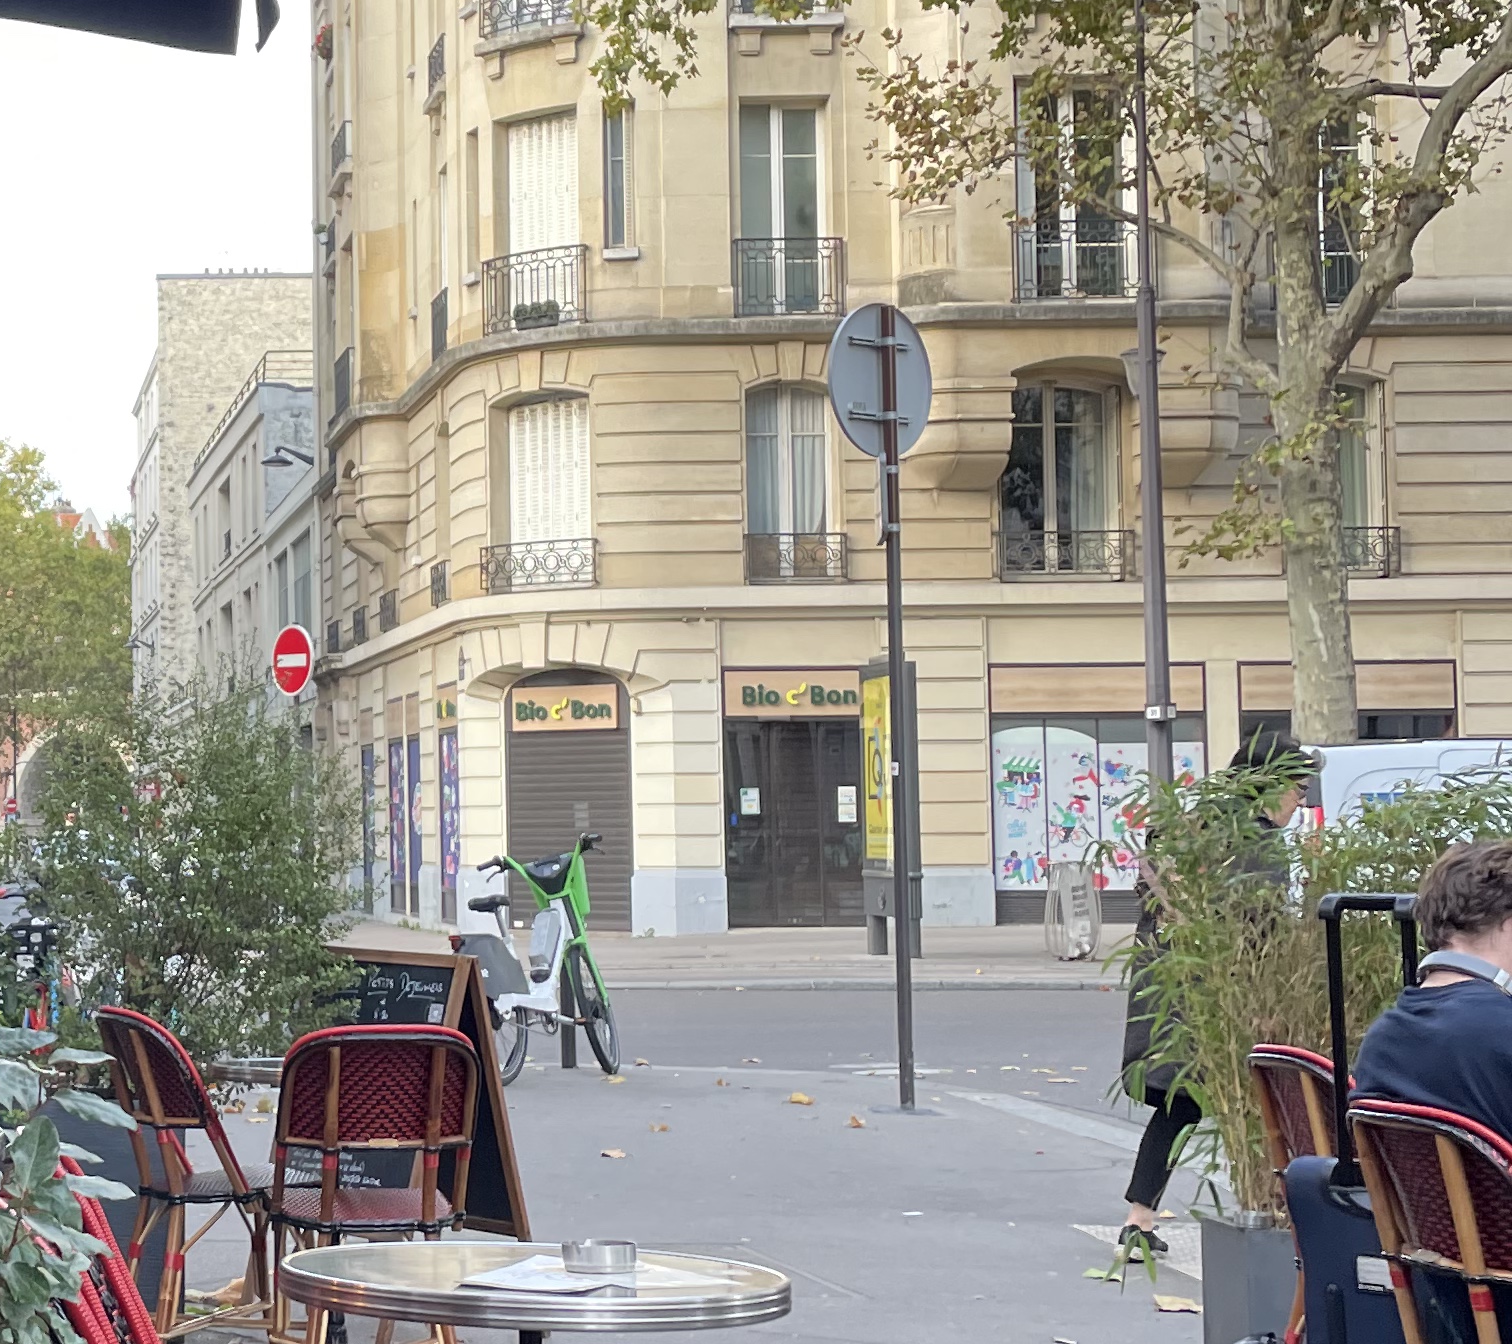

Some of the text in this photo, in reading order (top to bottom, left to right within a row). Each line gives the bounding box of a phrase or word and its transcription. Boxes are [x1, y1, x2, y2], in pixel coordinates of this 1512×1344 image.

[742, 683, 780, 705] Bio
[810, 685, 857, 705] Bon
[515, 699, 548, 721] Bio
[571, 699, 611, 720] Bon
